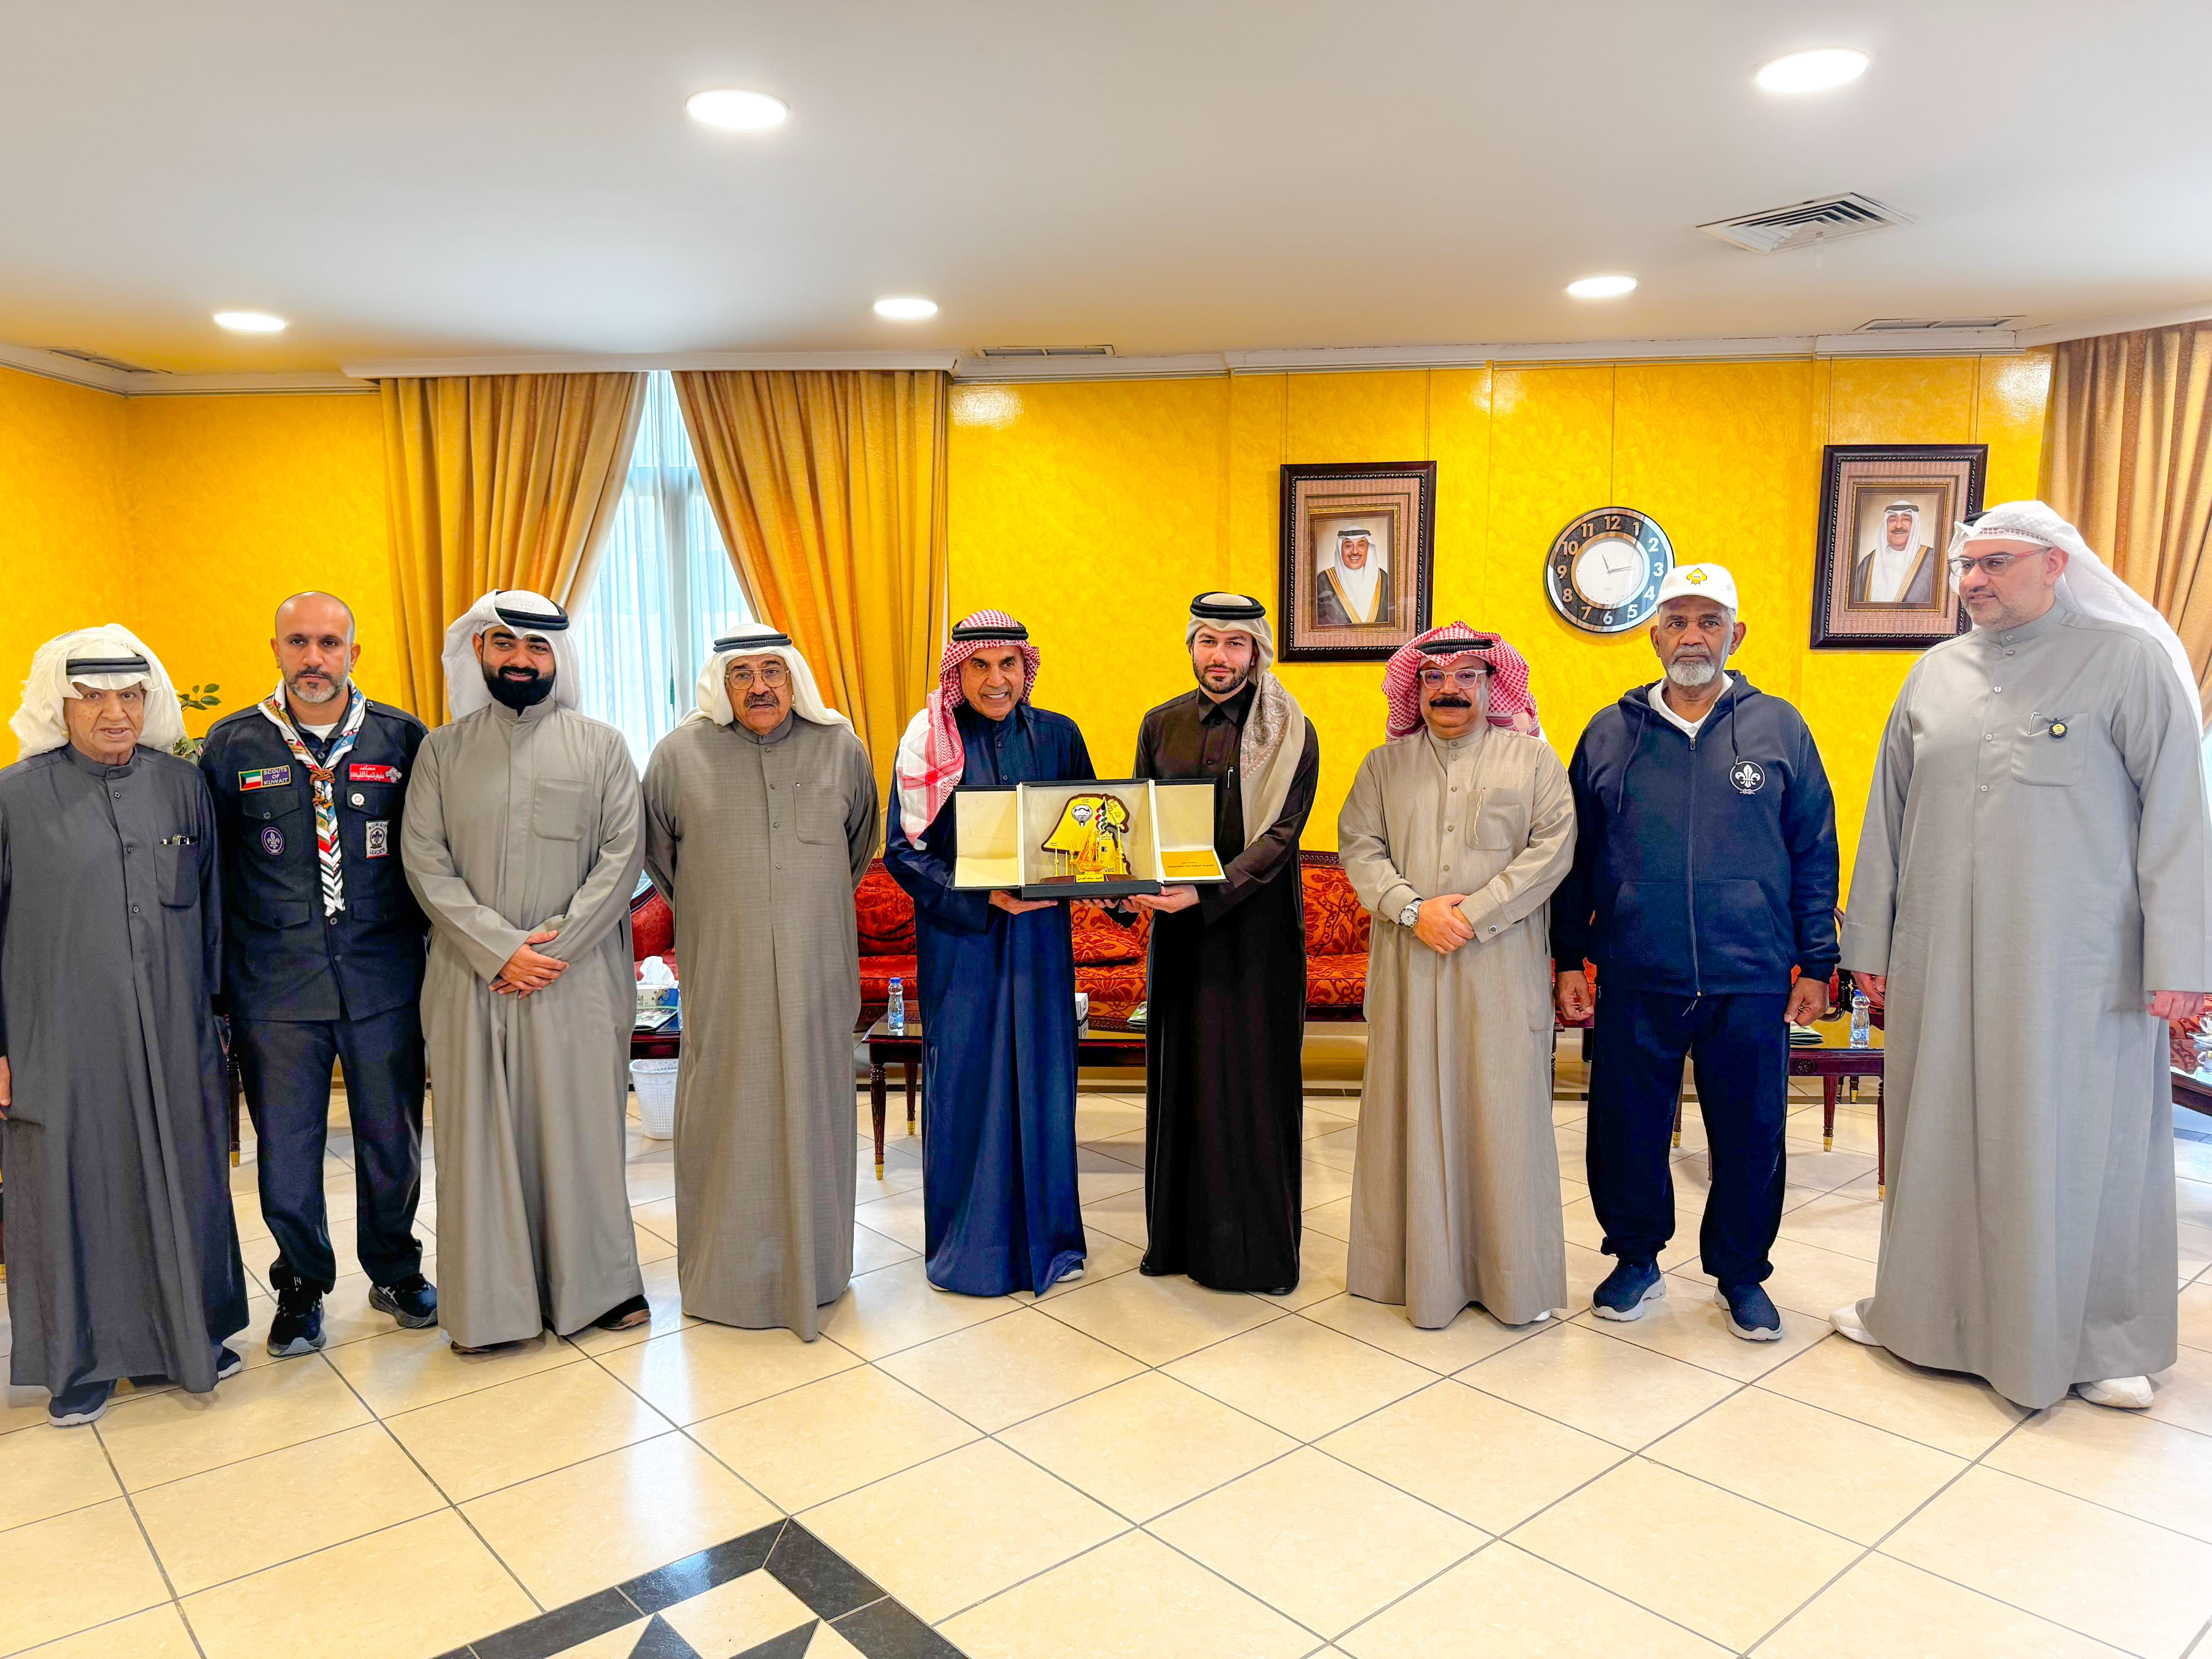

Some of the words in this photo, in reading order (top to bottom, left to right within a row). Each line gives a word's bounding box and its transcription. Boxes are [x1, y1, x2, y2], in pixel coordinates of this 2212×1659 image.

[1604, 515, 1620, 530] 12
[1633, 522, 1639, 536] 1
[1581, 523, 1594, 537] 11
[1562, 540, 1579, 556] 10
[1649, 537, 1659, 552] 2
[1557, 565, 1568, 579] 9
[1653, 562, 1664, 577] 3
[1562, 588, 1573, 602] 8
[1644, 586, 1655, 600] 4
[1581, 606, 1592, 620] 7
[1603, 611, 1613, 625] 6
[1627, 604, 1638, 618] 5
